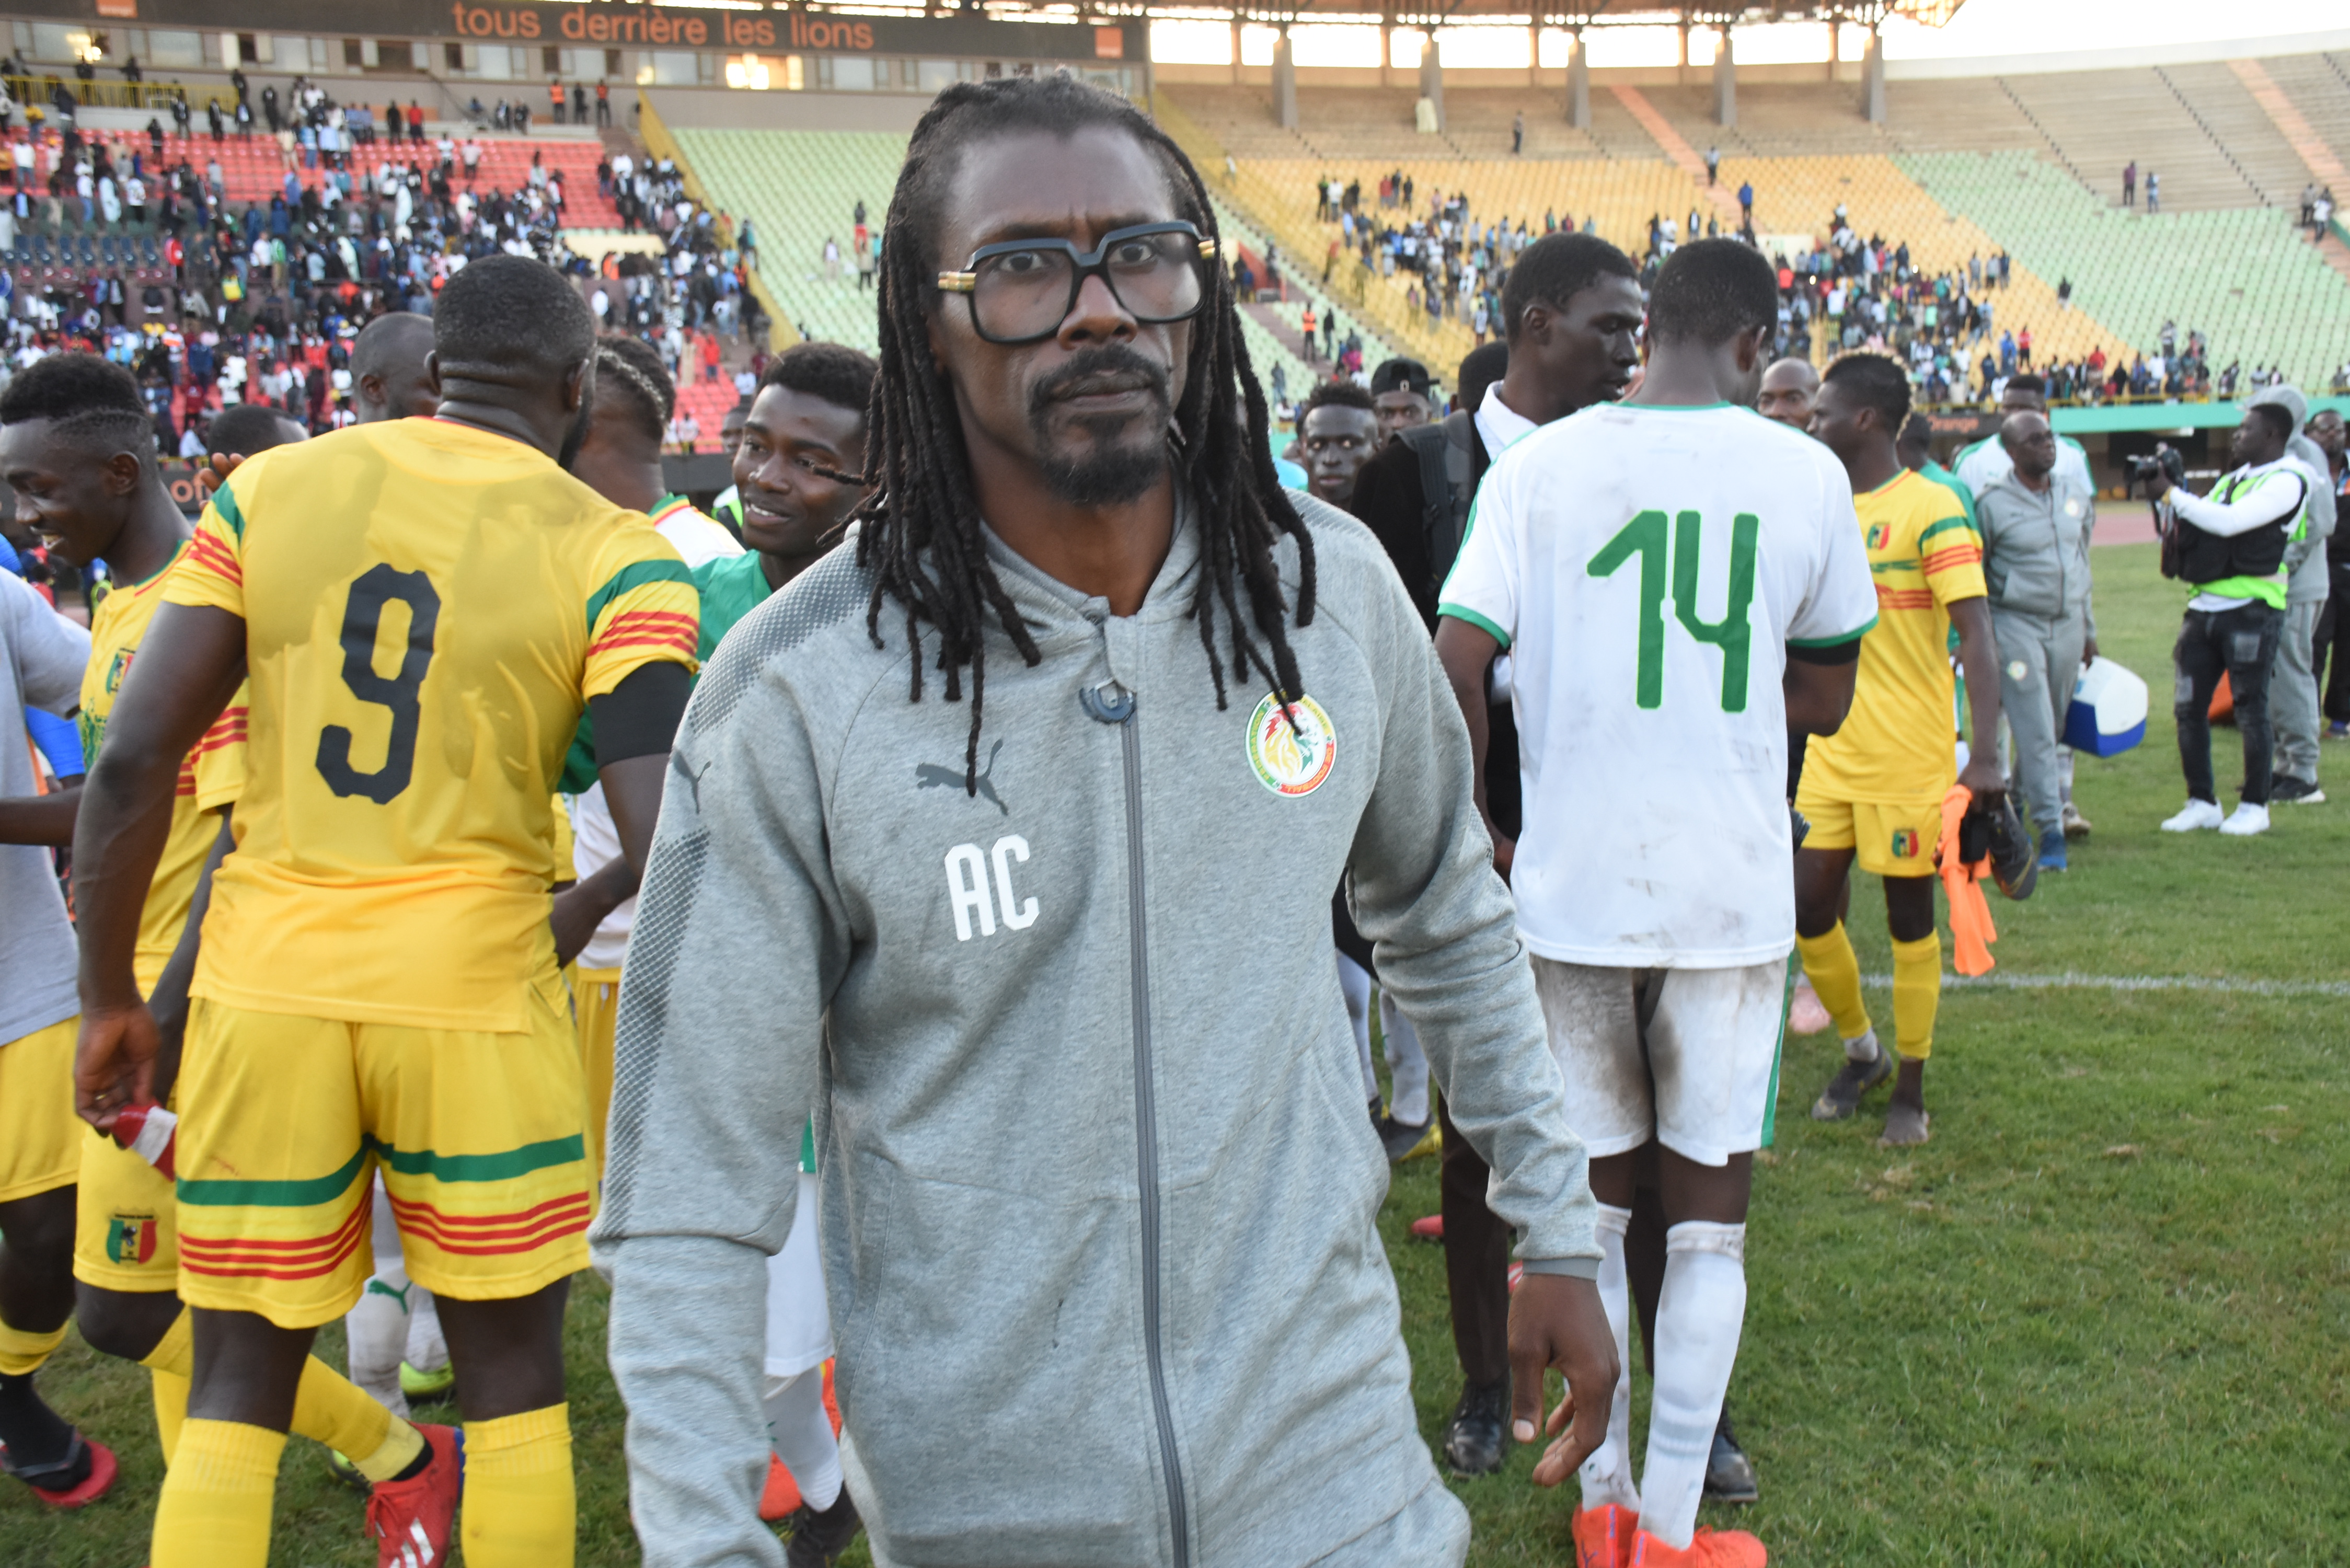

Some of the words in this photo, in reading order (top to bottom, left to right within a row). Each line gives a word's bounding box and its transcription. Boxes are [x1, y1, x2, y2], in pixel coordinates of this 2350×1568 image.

[452, 1, 542, 38] tous
[560, 4, 708, 45] derrière
[722, 10, 776, 46] les
[790, 12, 874, 50] lions
[315, 562, 441, 805] 9
[1586, 509, 1760, 713] 14
[944, 834, 1040, 942] AC
